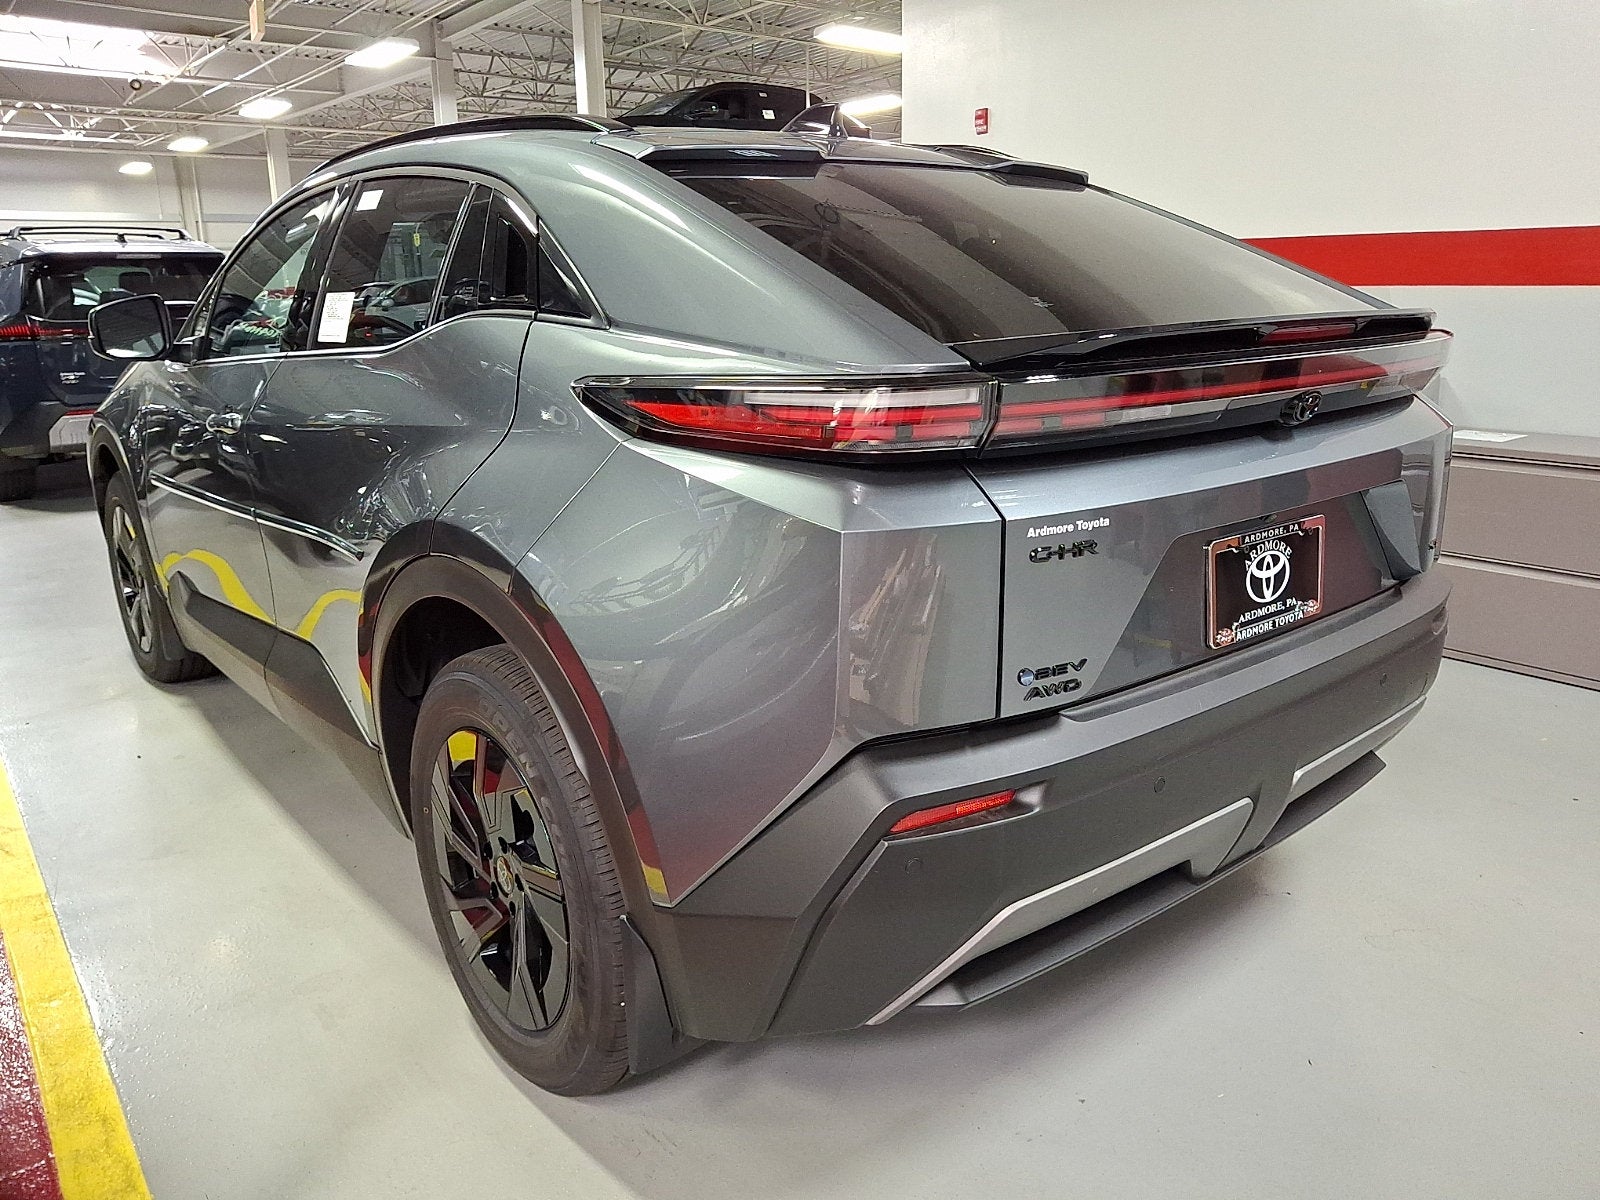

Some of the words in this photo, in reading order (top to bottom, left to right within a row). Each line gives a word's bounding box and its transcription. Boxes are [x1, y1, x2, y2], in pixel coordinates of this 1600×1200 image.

[1027, 523, 1075, 538] Ardmore
[1076, 517, 1110, 531] Toyota
[1289, 523, 1299, 532] PA
[1029, 540, 1099, 563] C-HR
[1245, 539, 1293, 571] ARDMORE
[1239, 601, 1285, 624] ARDMORE,
[1286, 597, 1297, 608] PA
[1236, 621, 1273, 641] ARDMORE
[1275, 610, 1304, 628] TOYOTA
[1035, 658, 1088, 680] BEV
[1023, 678, 1082, 701] AWD
